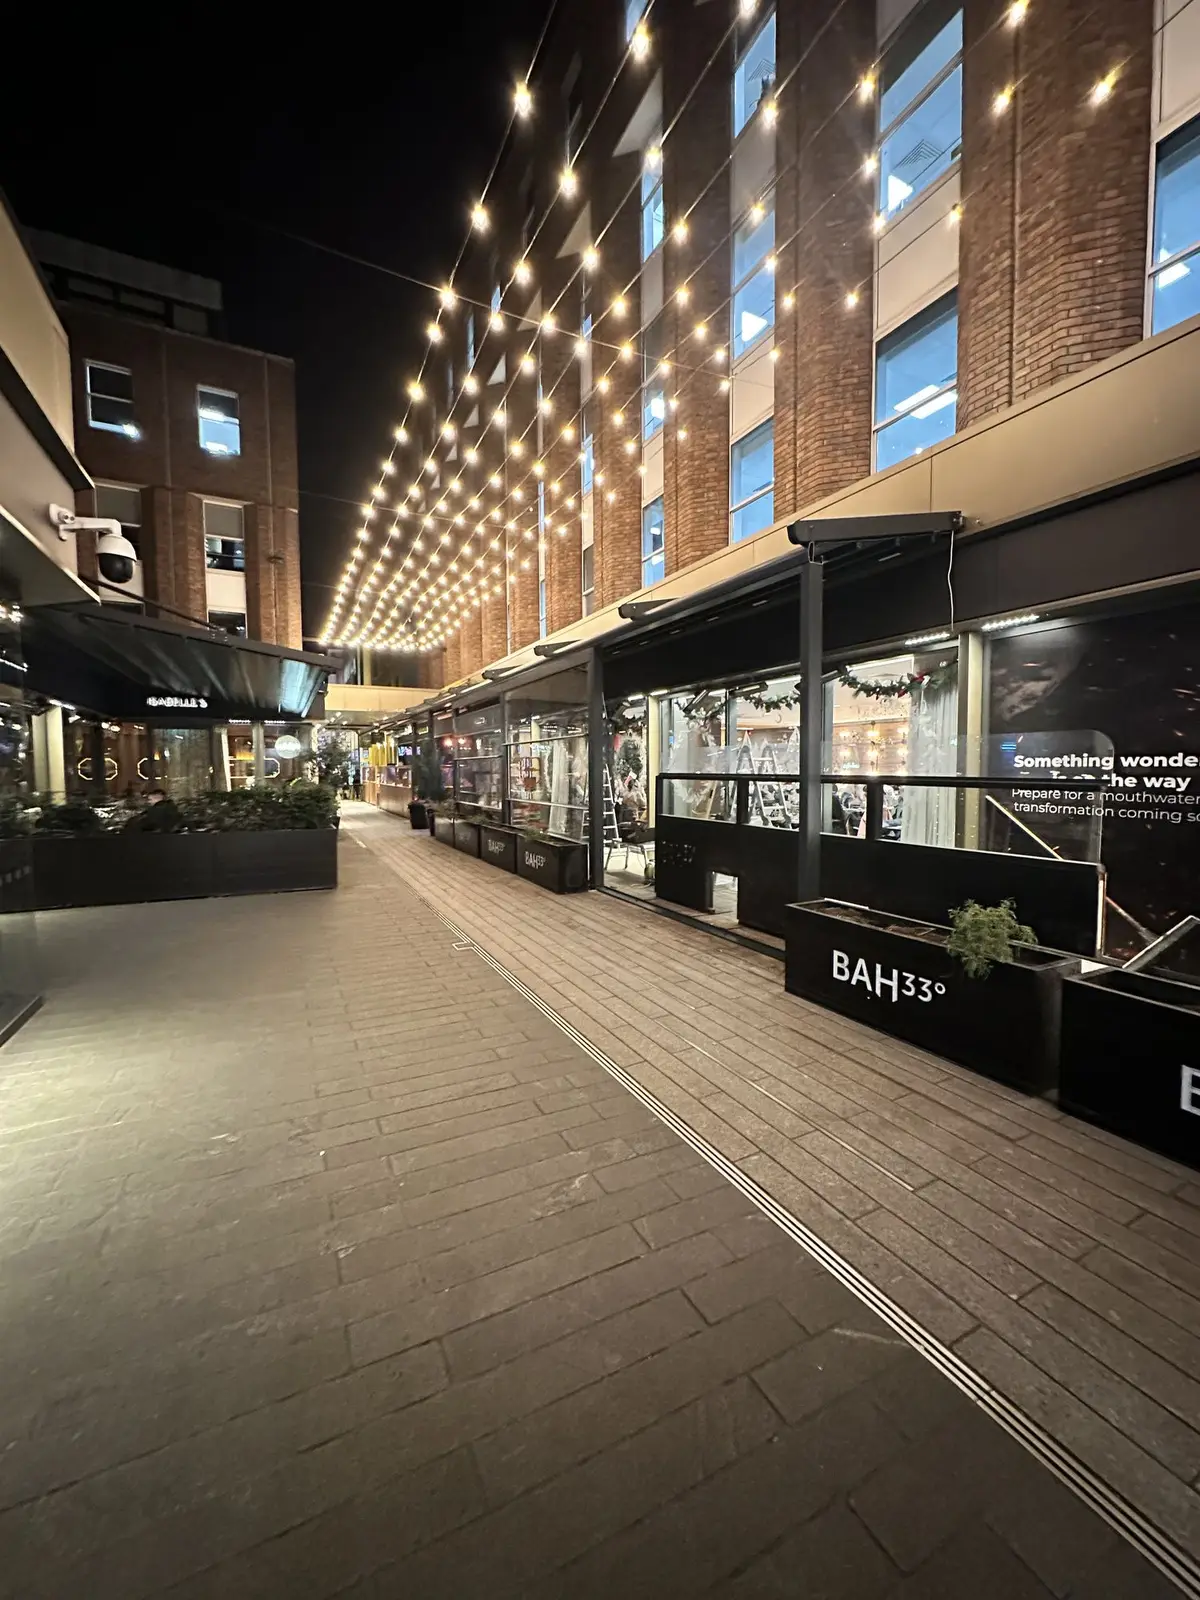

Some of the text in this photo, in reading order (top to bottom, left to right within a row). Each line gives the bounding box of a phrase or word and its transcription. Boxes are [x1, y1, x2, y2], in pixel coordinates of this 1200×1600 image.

[1013, 752, 1200, 770] Something wonde
[1143, 777, 1192, 792] way
[1012, 788, 1061, 800] Prepare
[1064, 790, 1083, 800] for
[1086, 791, 1095, 800] a
[1013, 802, 1114, 817] transformation
[1118, 808, 1182, 824] coming
